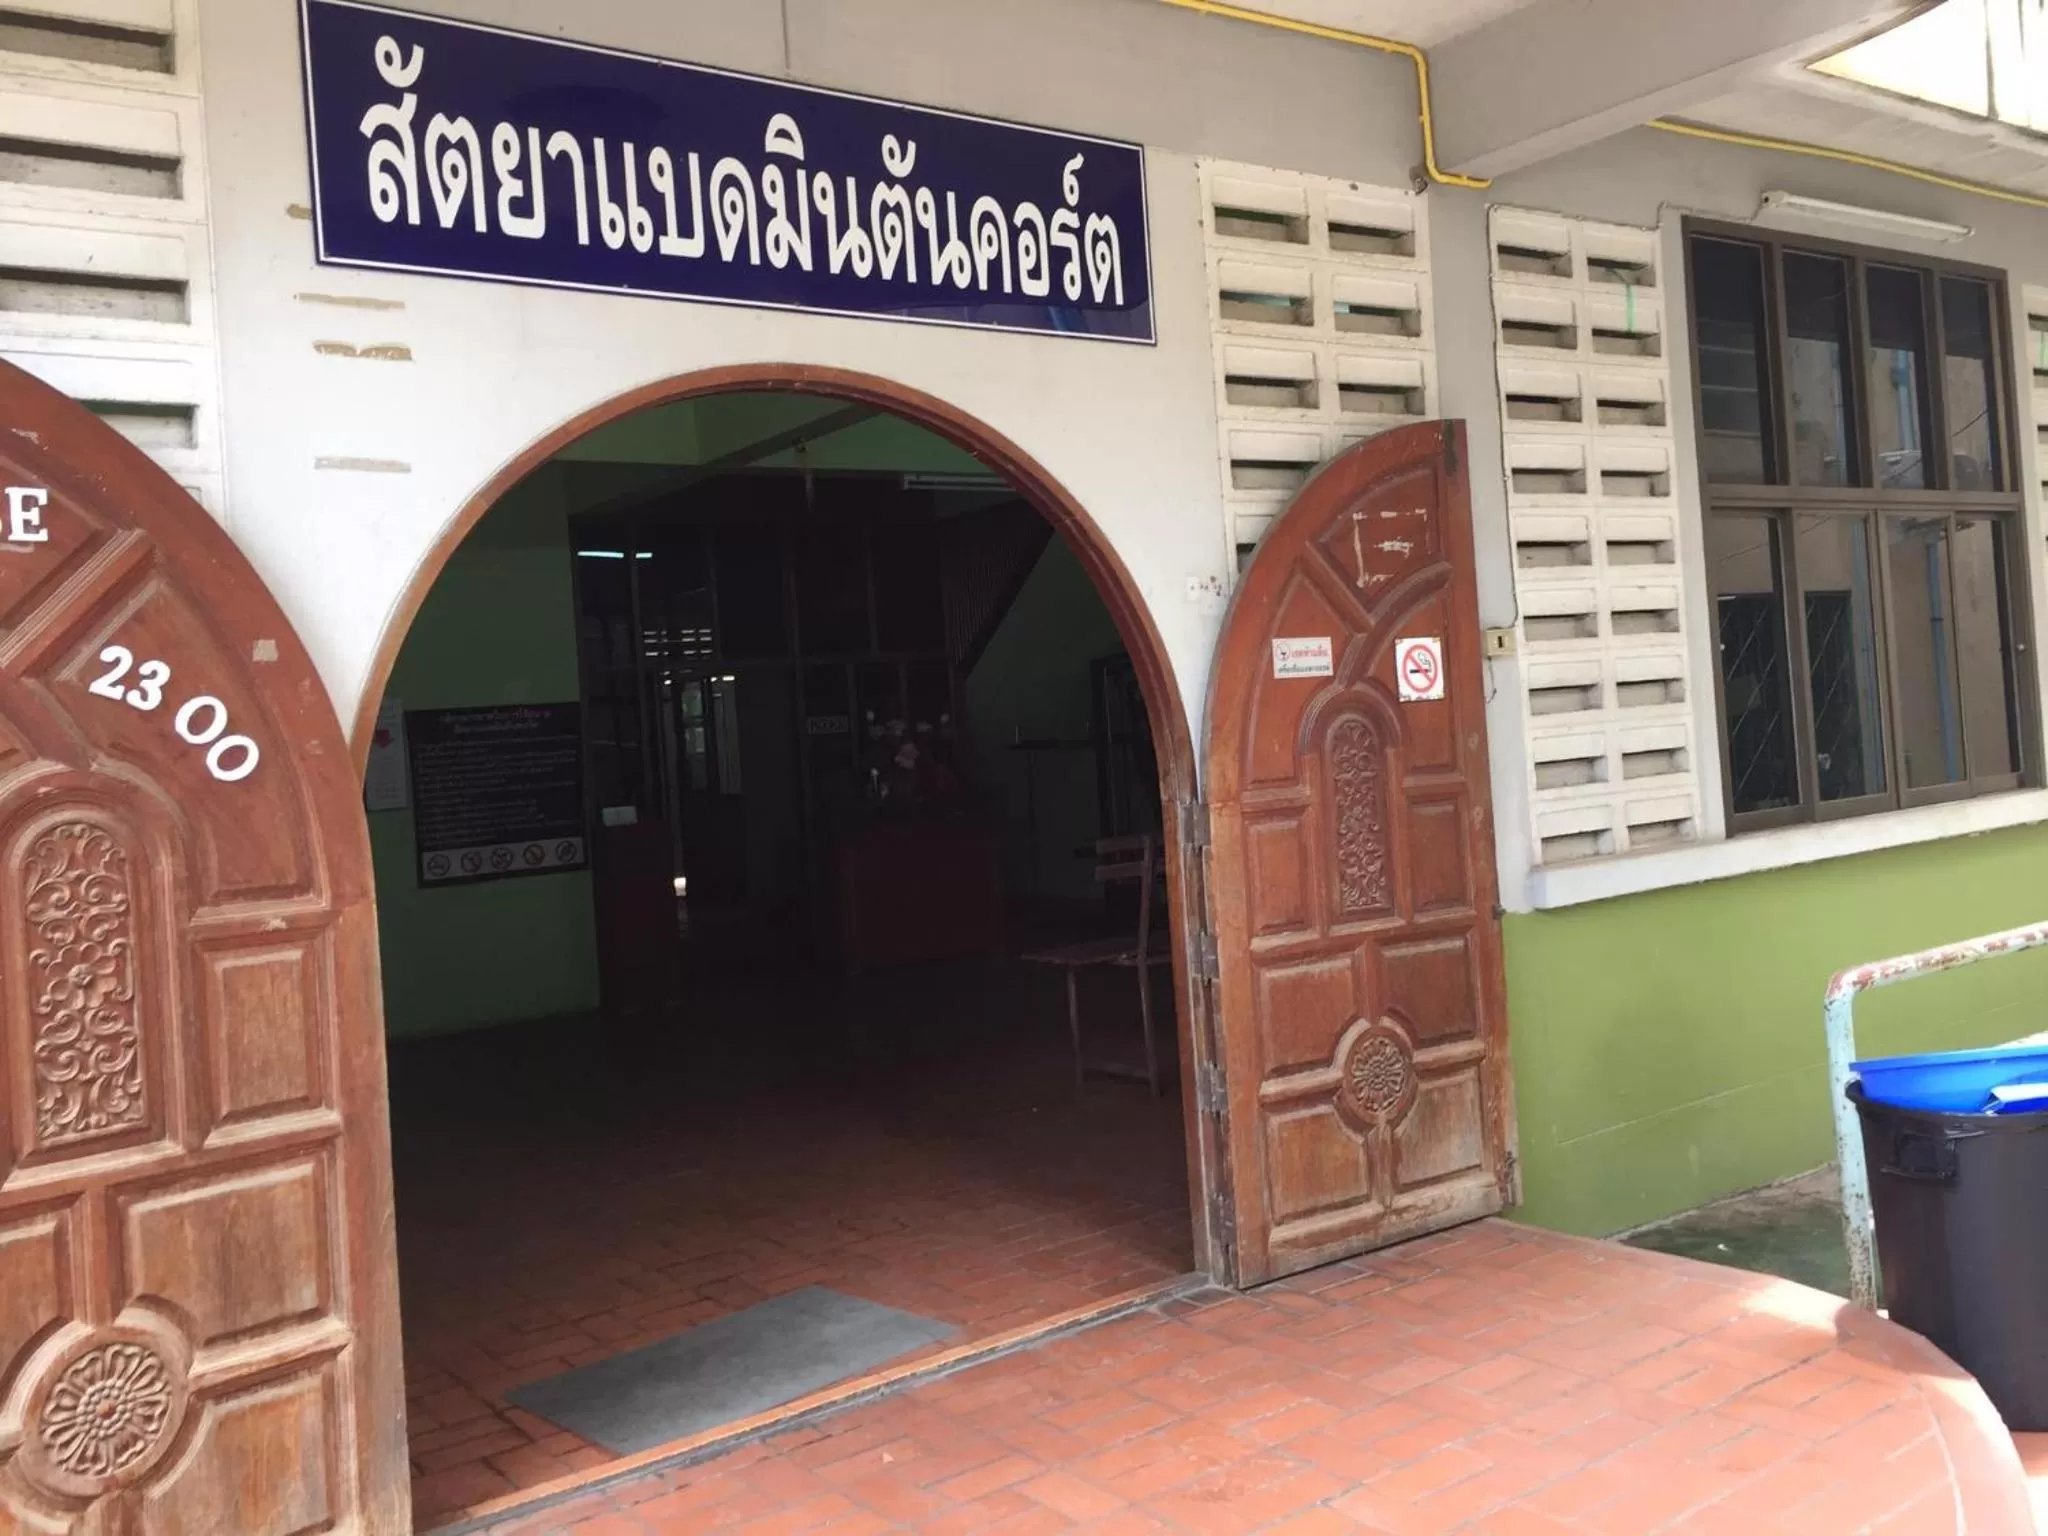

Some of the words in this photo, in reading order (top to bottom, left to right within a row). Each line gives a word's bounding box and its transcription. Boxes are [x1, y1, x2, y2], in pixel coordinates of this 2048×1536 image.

[360, 35, 1125, 306] สัตยาแบดมินตันคอร์ต
[0, 486, 48, 541] E
